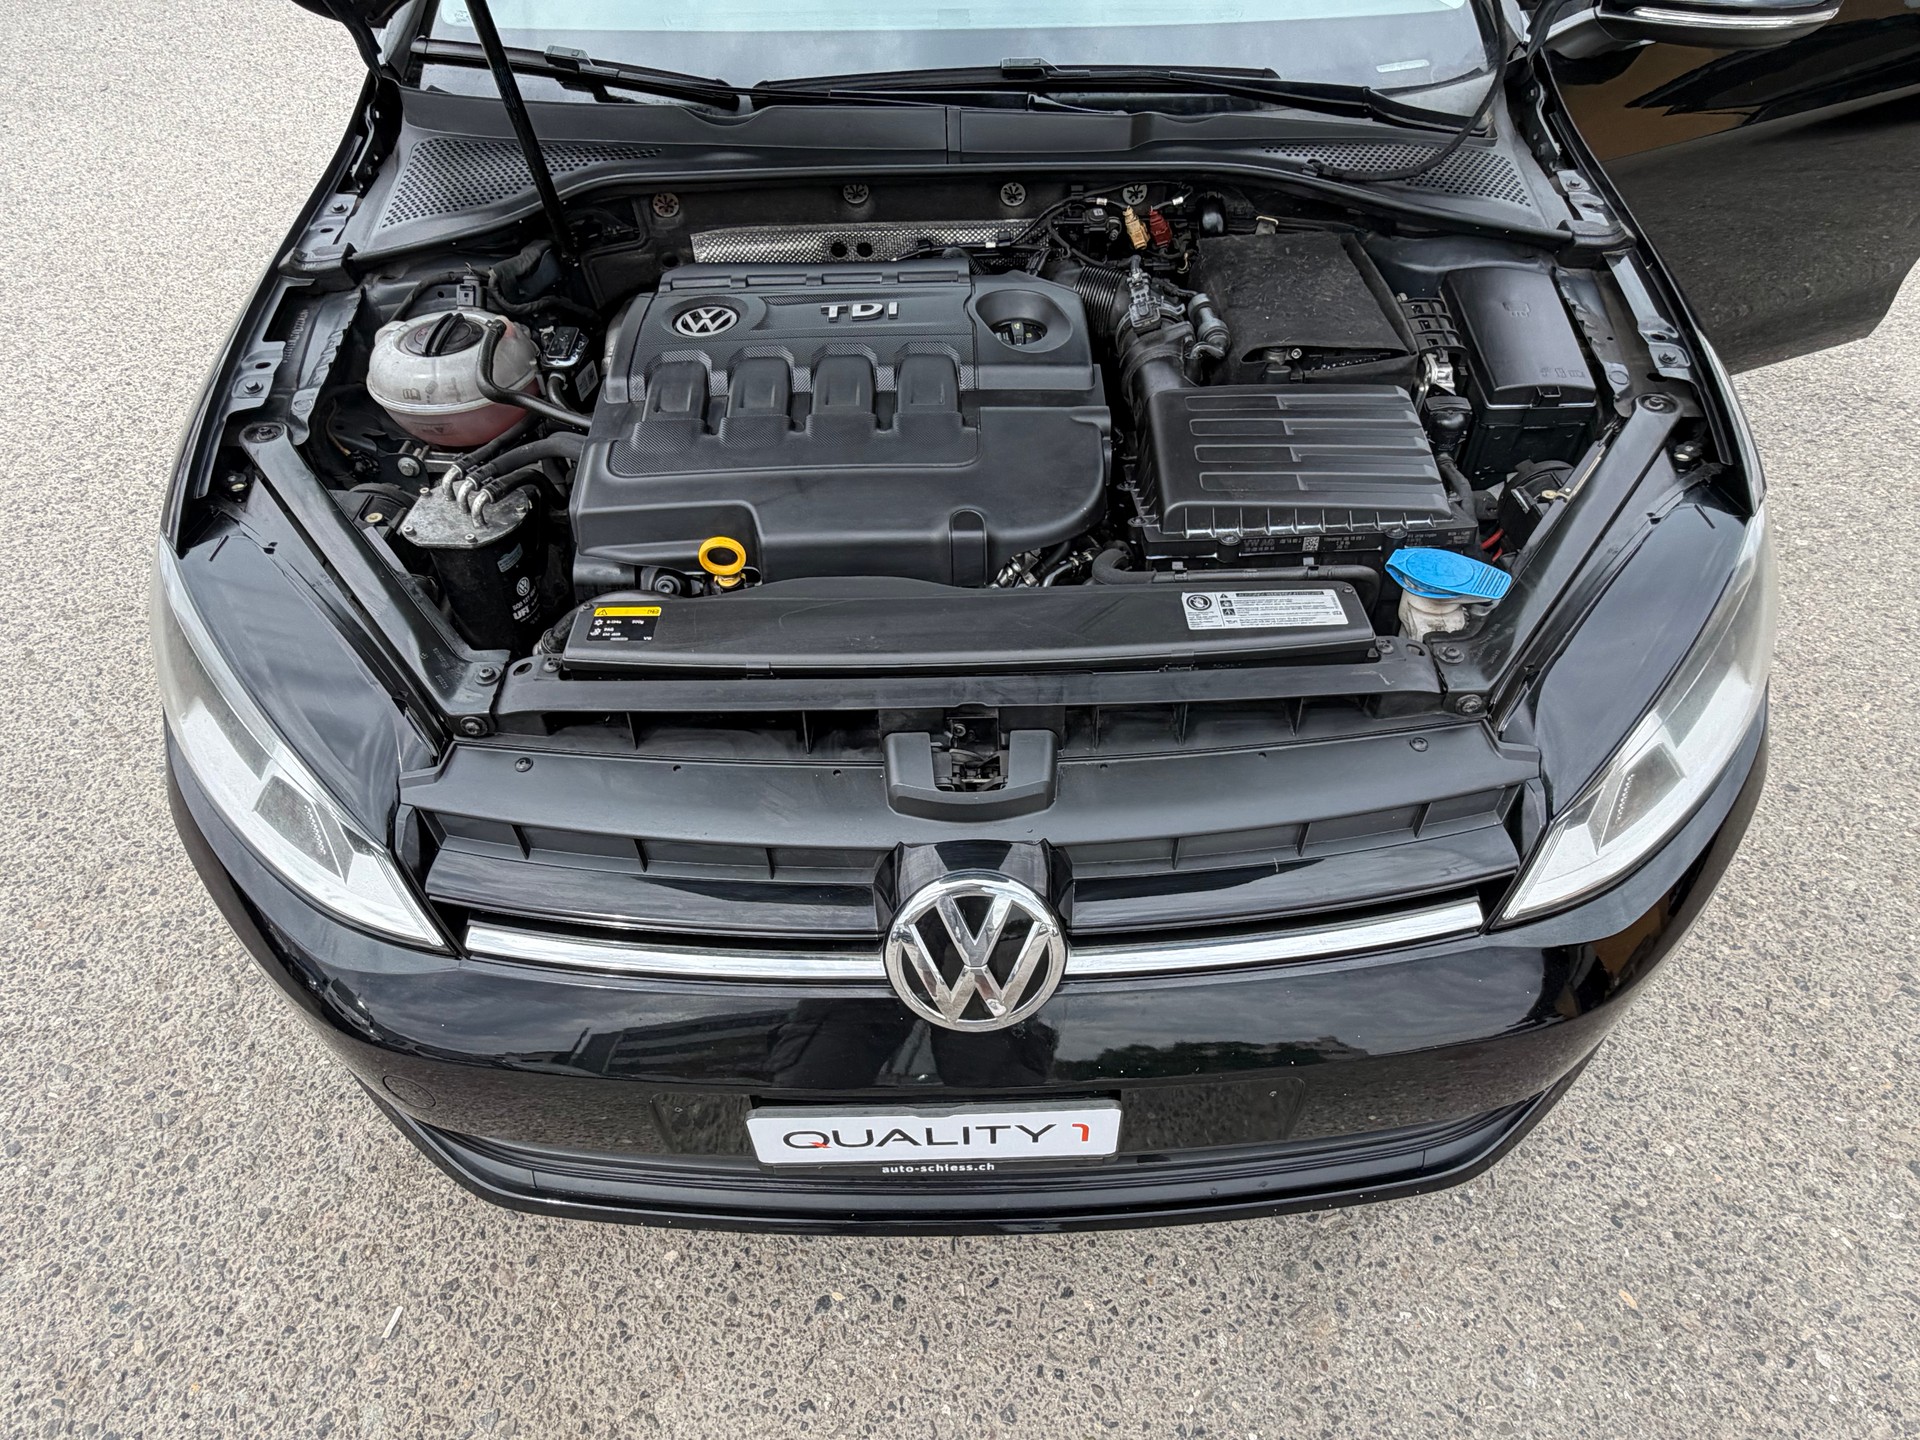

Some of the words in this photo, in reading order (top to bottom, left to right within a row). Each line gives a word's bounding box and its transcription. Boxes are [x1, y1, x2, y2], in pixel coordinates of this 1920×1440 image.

[820, 301, 899, 322] TDI
[884, 868, 1067, 1032] VW
[782, 1123, 1057, 1149] QUALITY
[1071, 1122, 1090, 1142] 1
[881, 1161, 996, 1174] auto-schiess.ch
